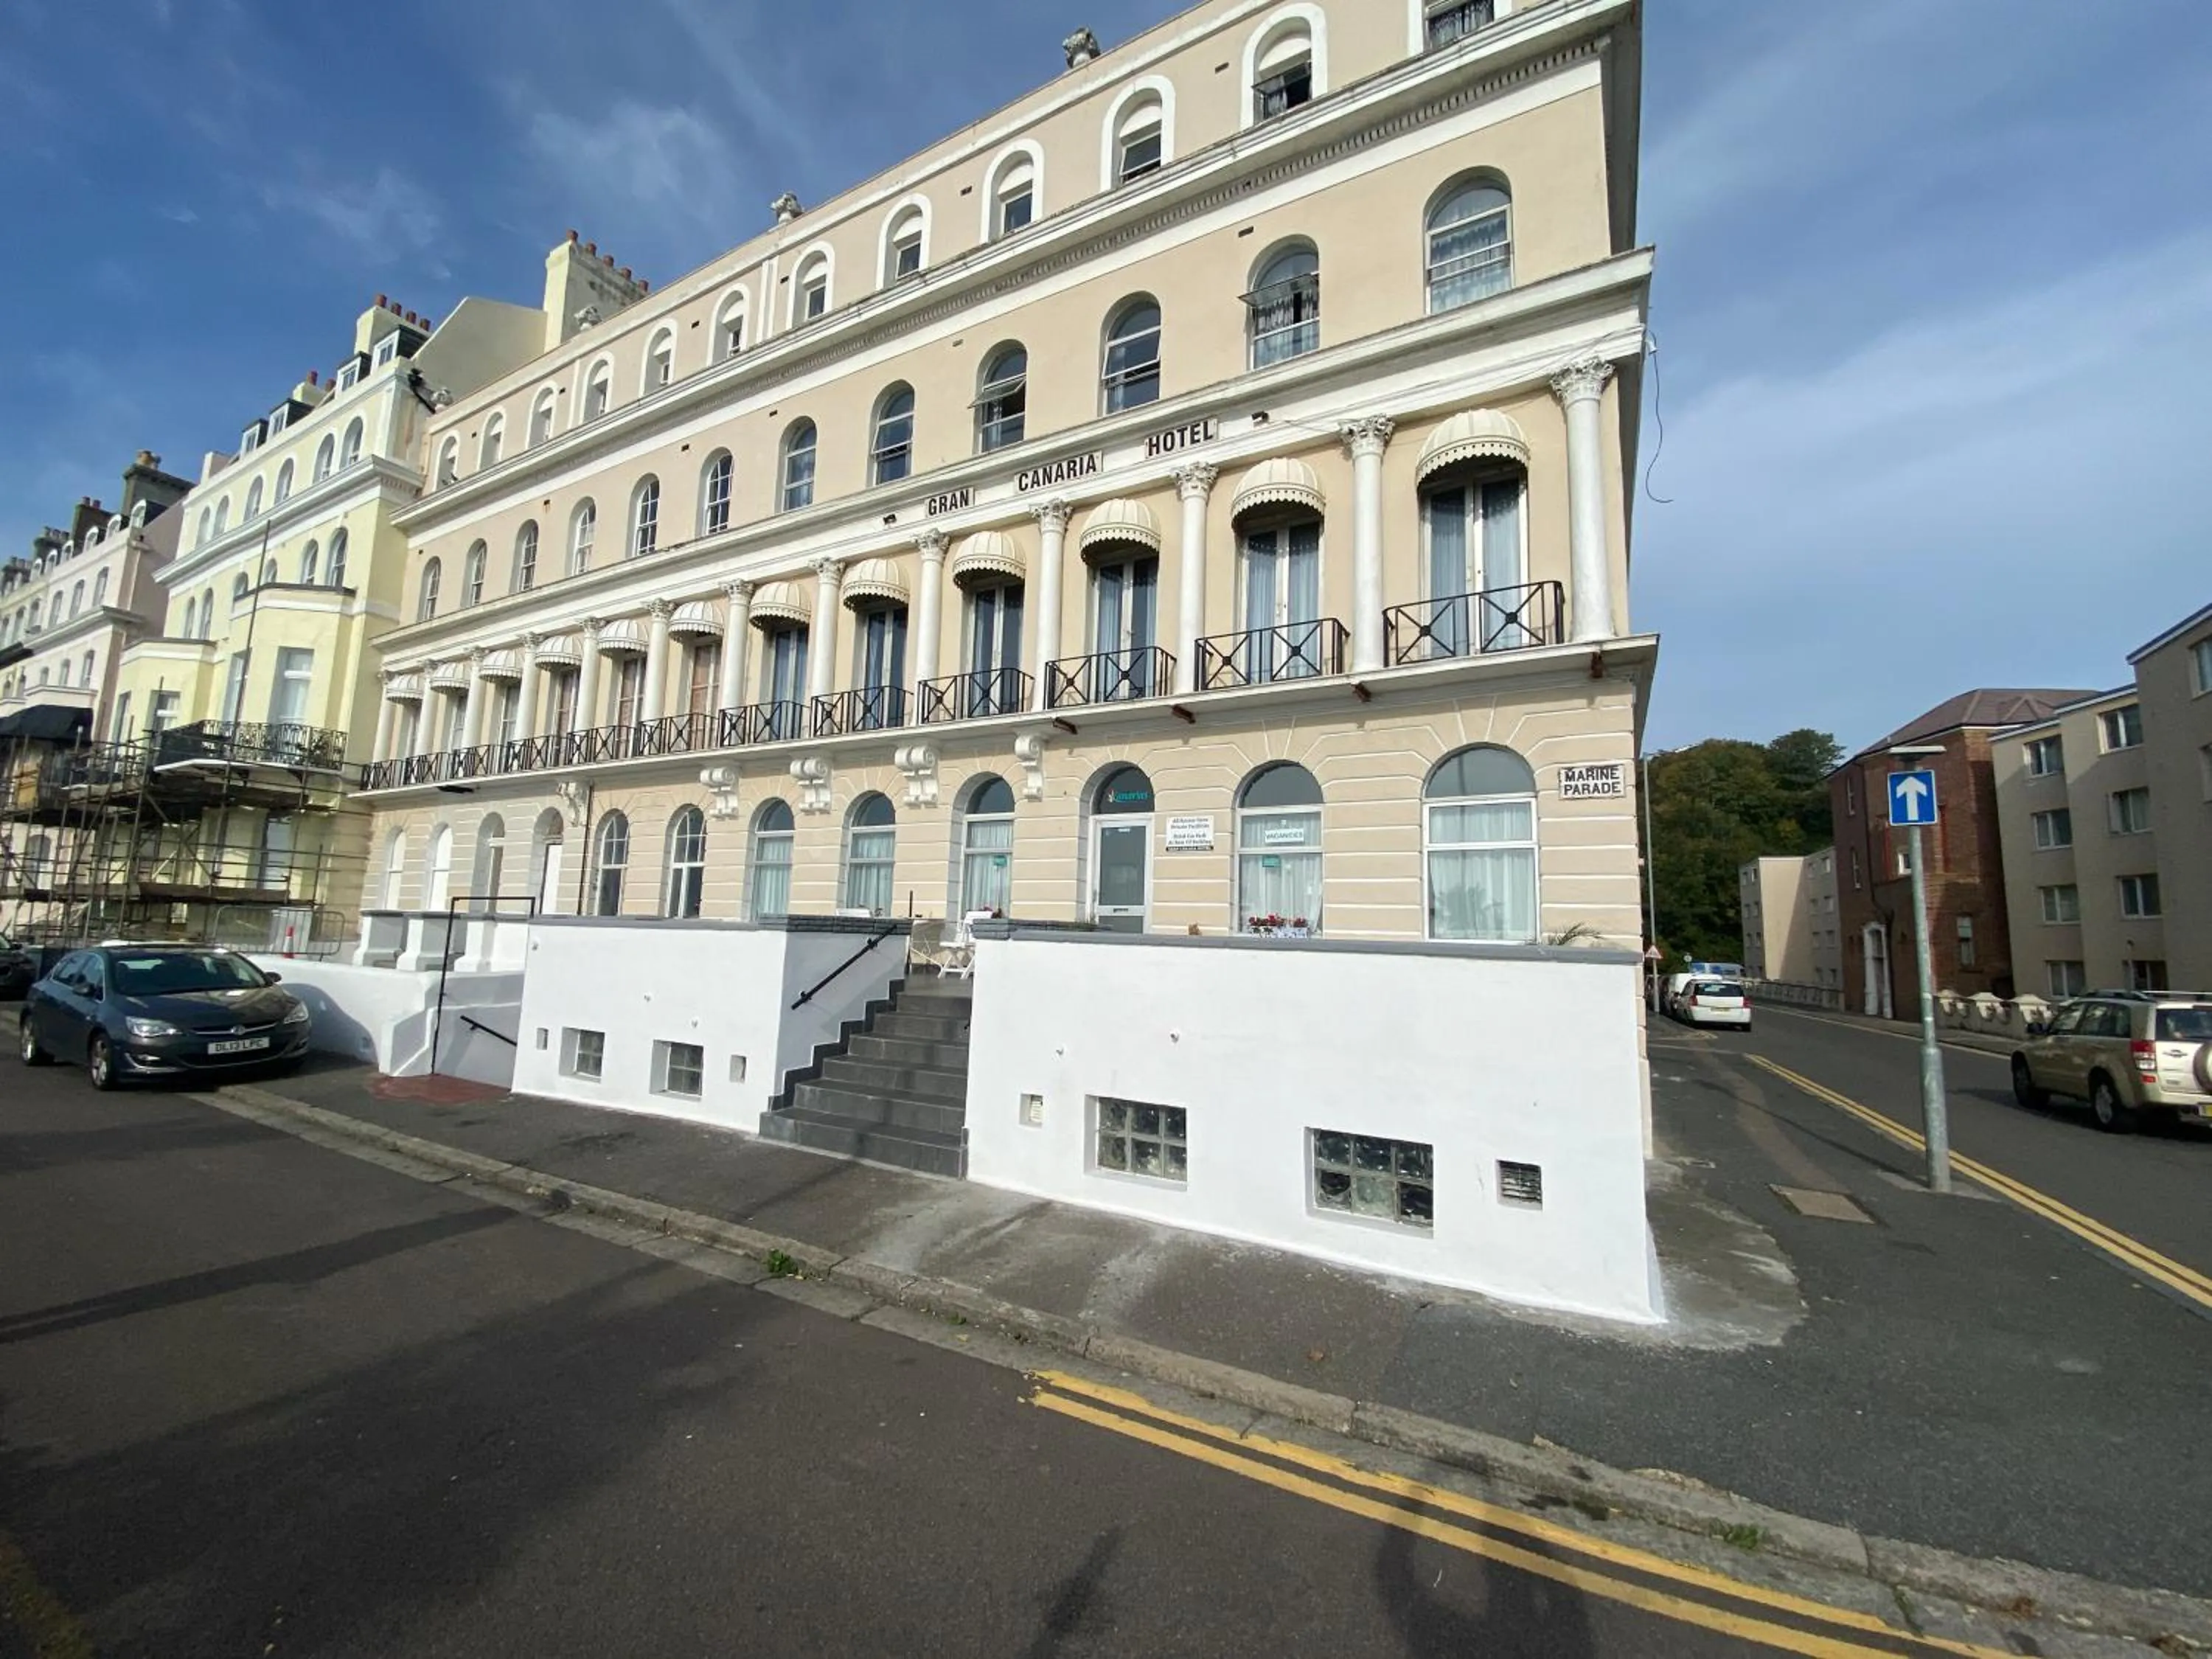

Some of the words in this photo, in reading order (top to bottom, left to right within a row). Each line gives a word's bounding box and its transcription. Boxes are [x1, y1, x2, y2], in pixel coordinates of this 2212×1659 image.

[928, 490, 969, 515] GRAN
[1018, 454, 1096, 492] CANARIA
[1148, 421, 1214, 456] HOTEL
[1564, 767, 1620, 782] MARINE
[1564, 782, 1621, 796] PARADE
[1266, 831, 1303, 839] VACANCIES
